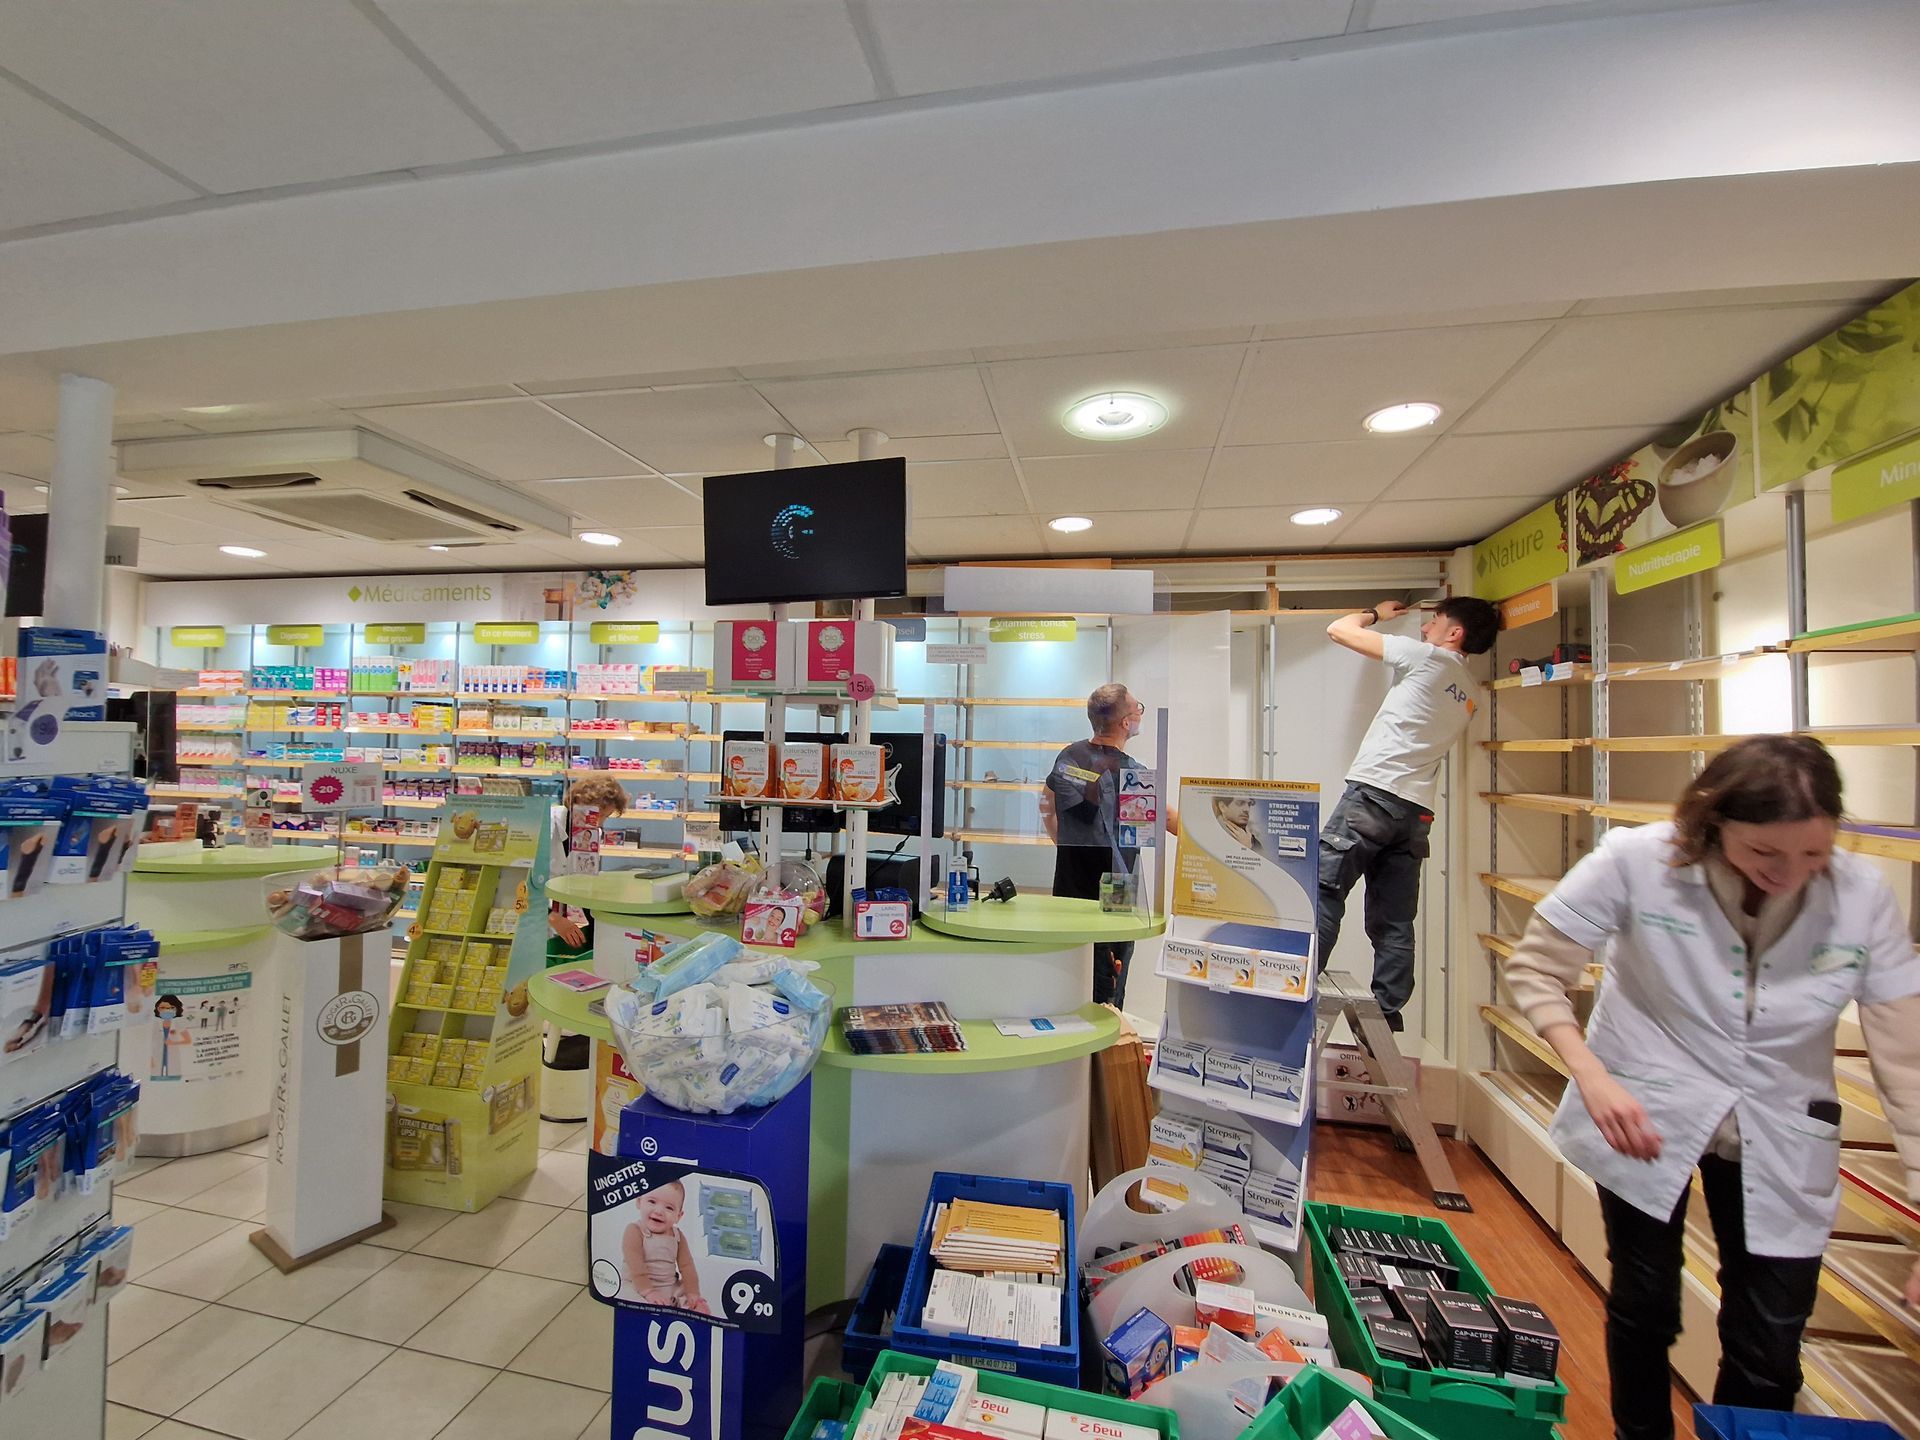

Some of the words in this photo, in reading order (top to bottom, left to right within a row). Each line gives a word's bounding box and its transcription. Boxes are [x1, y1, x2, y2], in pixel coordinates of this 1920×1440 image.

[1488, 528, 1545, 574] Nature
[1628, 542, 1701, 577] Nutrithérapie
[364, 582, 492, 603] Médicaments
[1018, 630, 1046, 640] stress
[330, 766, 358, 774] NUXE
[1268, 802, 1300, 810] STREPSILS
[1268, 809, 1299, 817] LIDOCAÏNE
[1267, 822, 1311, 831] SOULAGEMENT
[1167, 943, 1205, 957] Strepsils
[1211, 952, 1251, 966] Strepsils
[1259, 958, 1302, 972] Strepsils
[278, 994, 292, 1069] GALLET
[1161, 1044, 1194, 1060] Strepsils
[1207, 1056, 1242, 1071] Strepsils
[1255, 1068, 1292, 1084] Strepsils
[275, 1086, 288, 1165] ROGER
[399, 1118, 421, 1128] CITRATE
[400, 1128, 416, 1137] UPSA
[1153, 1124, 1186, 1140] Strepsils
[1207, 1125, 1241, 1141] Strepsils
[593, 1161, 647, 1192] LINGETTES
[602, 1189, 623, 1206] LOT
[623, 1182, 640, 1198] DE
[641, 1177, 650, 1191] 3
[1247, 1190, 1285, 1208] Strepsils
[1442, 1300, 1481, 1310] CAP-ACTIFS
[1503, 1304, 1542, 1318] CAP-ACTIFS
[1257, 1304, 1312, 1322] GURONSAN
[1454, 1329, 1493, 1340] CAP-ACTIFS
[1514, 1333, 1555, 1347] CAP-ACTIFS
[981, 1399, 1010, 1415] mag
[1080, 1422, 1089, 1432] 2
[1093, 1423, 1123, 1438] mag
